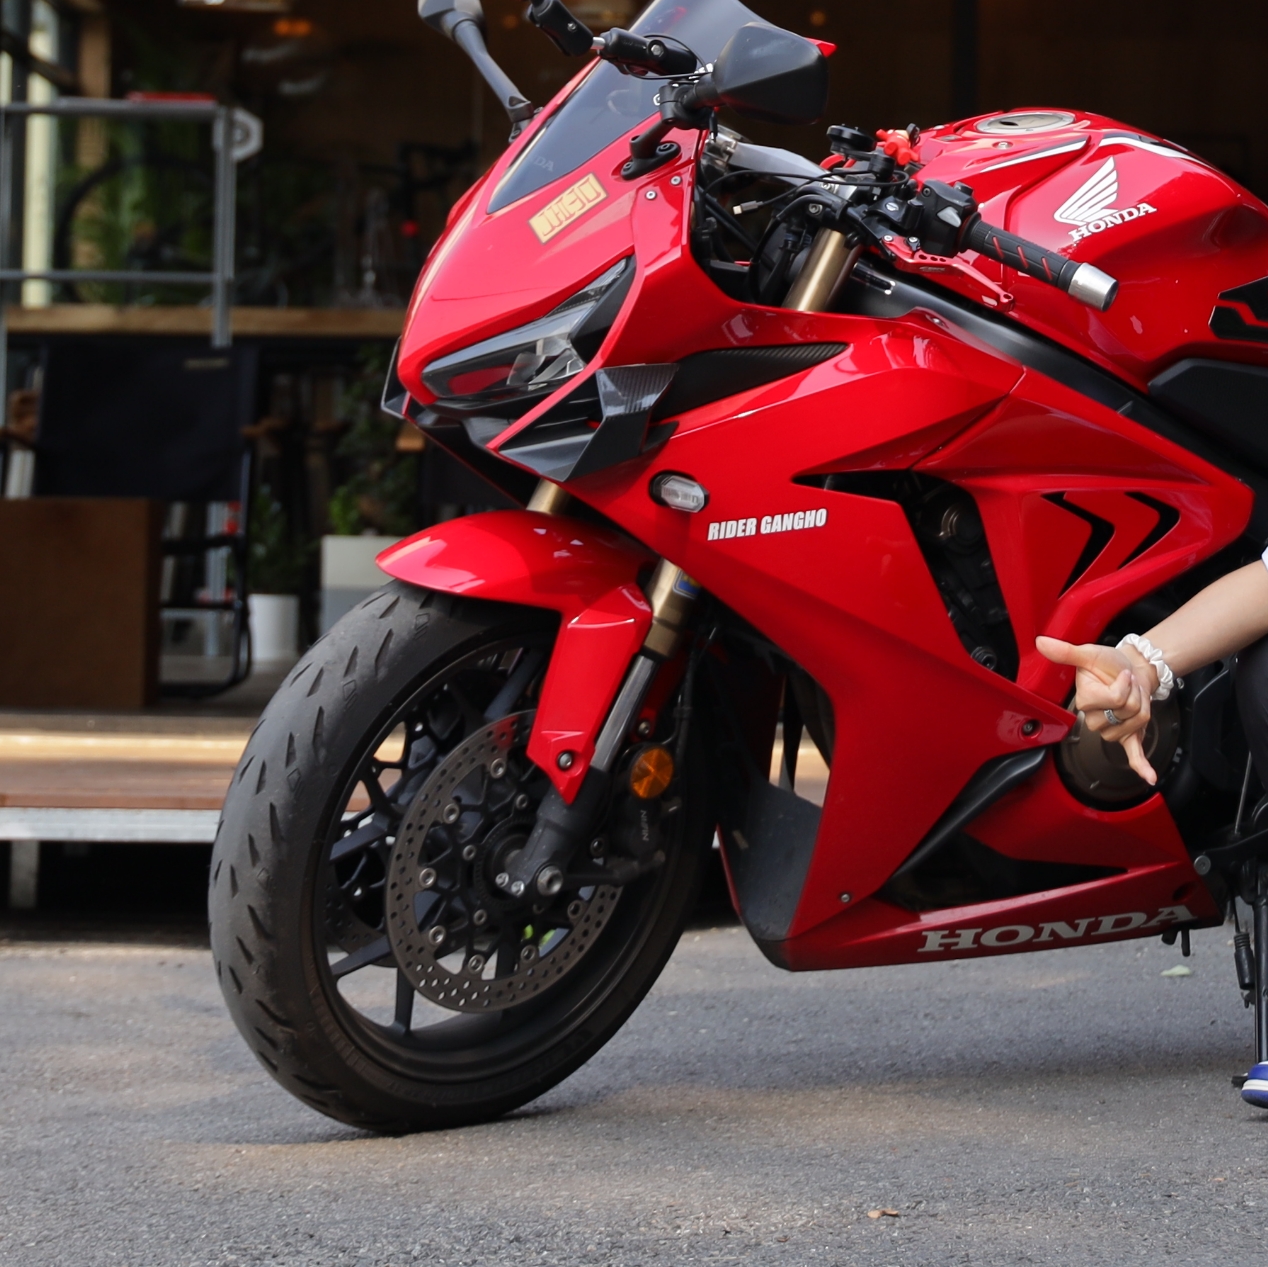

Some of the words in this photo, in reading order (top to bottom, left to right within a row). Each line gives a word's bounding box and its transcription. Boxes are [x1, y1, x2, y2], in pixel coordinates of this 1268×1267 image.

[1068, 202, 1157, 242] HONDA
[707, 517, 757, 541] RIDER
[760, 508, 828, 534] GANGHO
[917, 904, 1198, 953] HONDA
